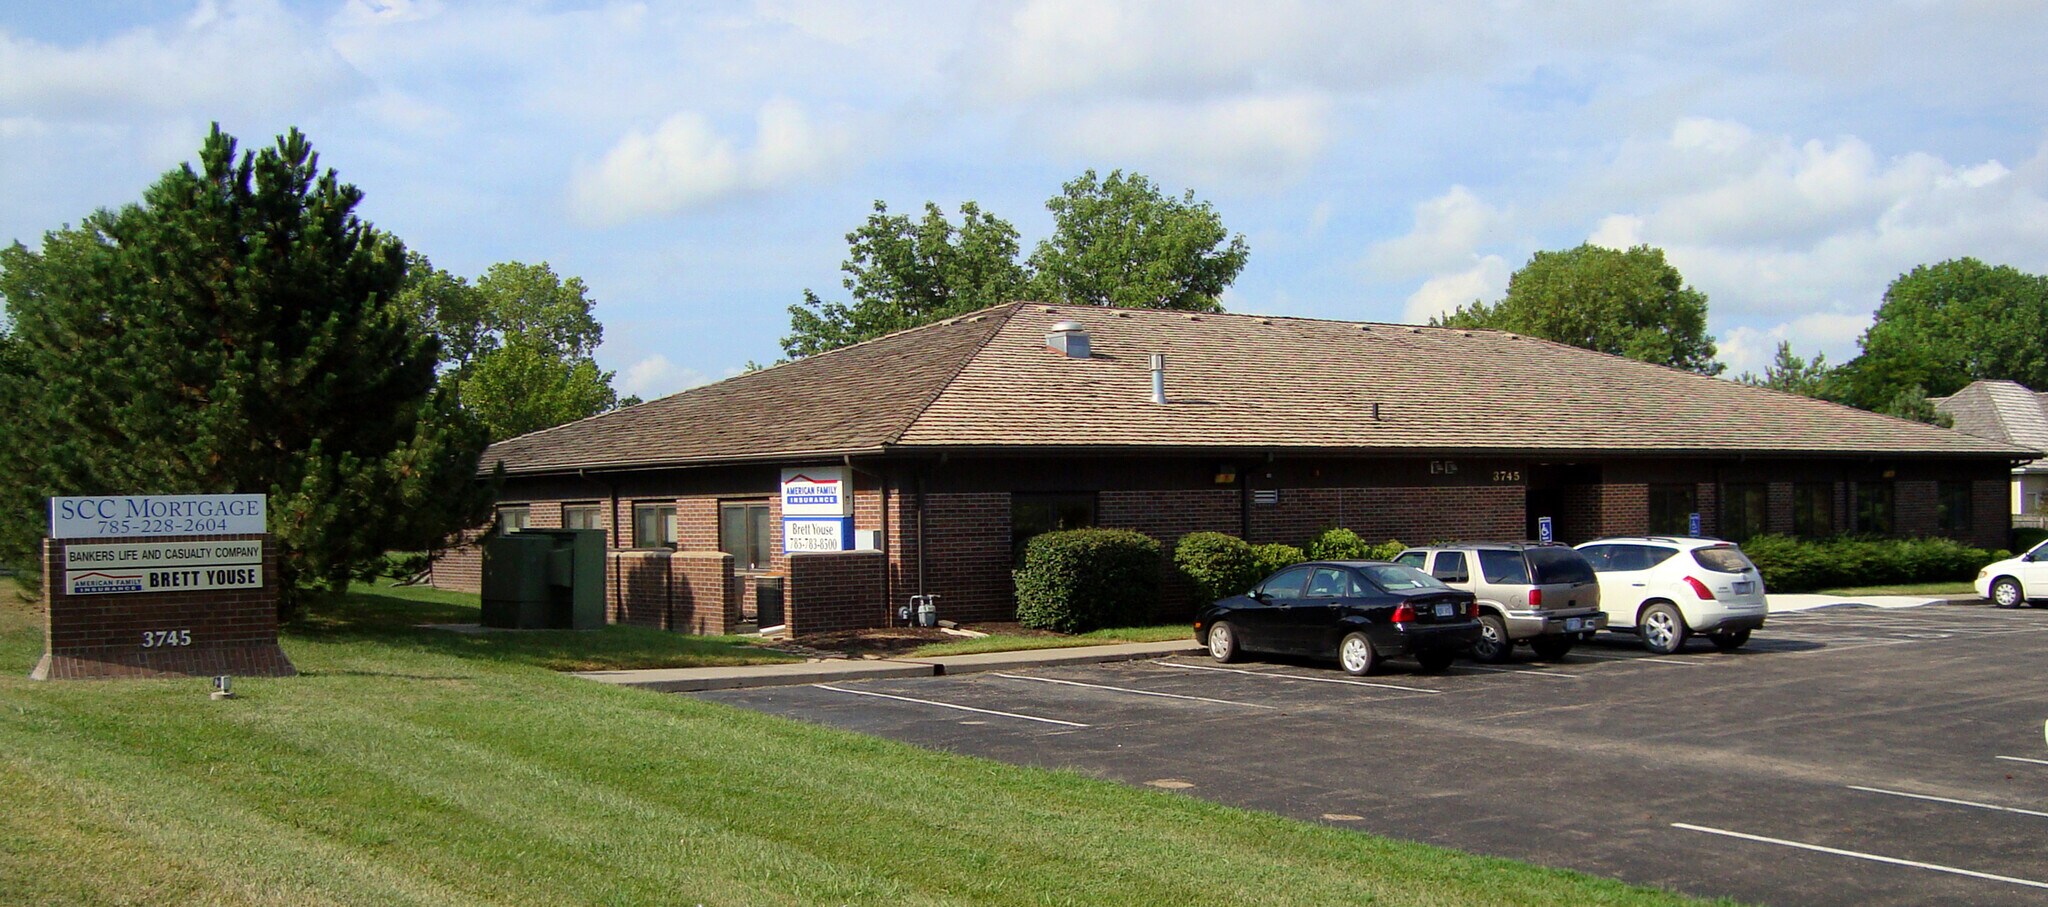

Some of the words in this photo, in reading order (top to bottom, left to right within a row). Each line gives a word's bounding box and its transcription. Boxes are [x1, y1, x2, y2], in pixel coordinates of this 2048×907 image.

[1493, 471, 1520, 481] 3745
[787, 486, 815, 495] AMERICAN
[816, 486, 837, 495] FAMILY
[61, 499, 117, 520] SCC
[126, 498, 260, 519] MORTGAGE
[98, 518, 228, 534] 785-228-2604
[792, 523, 811, 535] Brett
[812, 523, 834, 535] Youse
[790, 537, 838, 550] 785-783-8500
[69, 550, 115, 562] BANKERS
[118, 549, 138, 561] LIFE
[141, 549, 162, 560] AND
[165, 547, 212, 559] CASUALTY
[215, 547, 260, 558] COMPANY
[149, 571, 200, 588] BRETT
[206, 569, 256, 586] YOUSE
[142, 630, 192, 648] 3745
